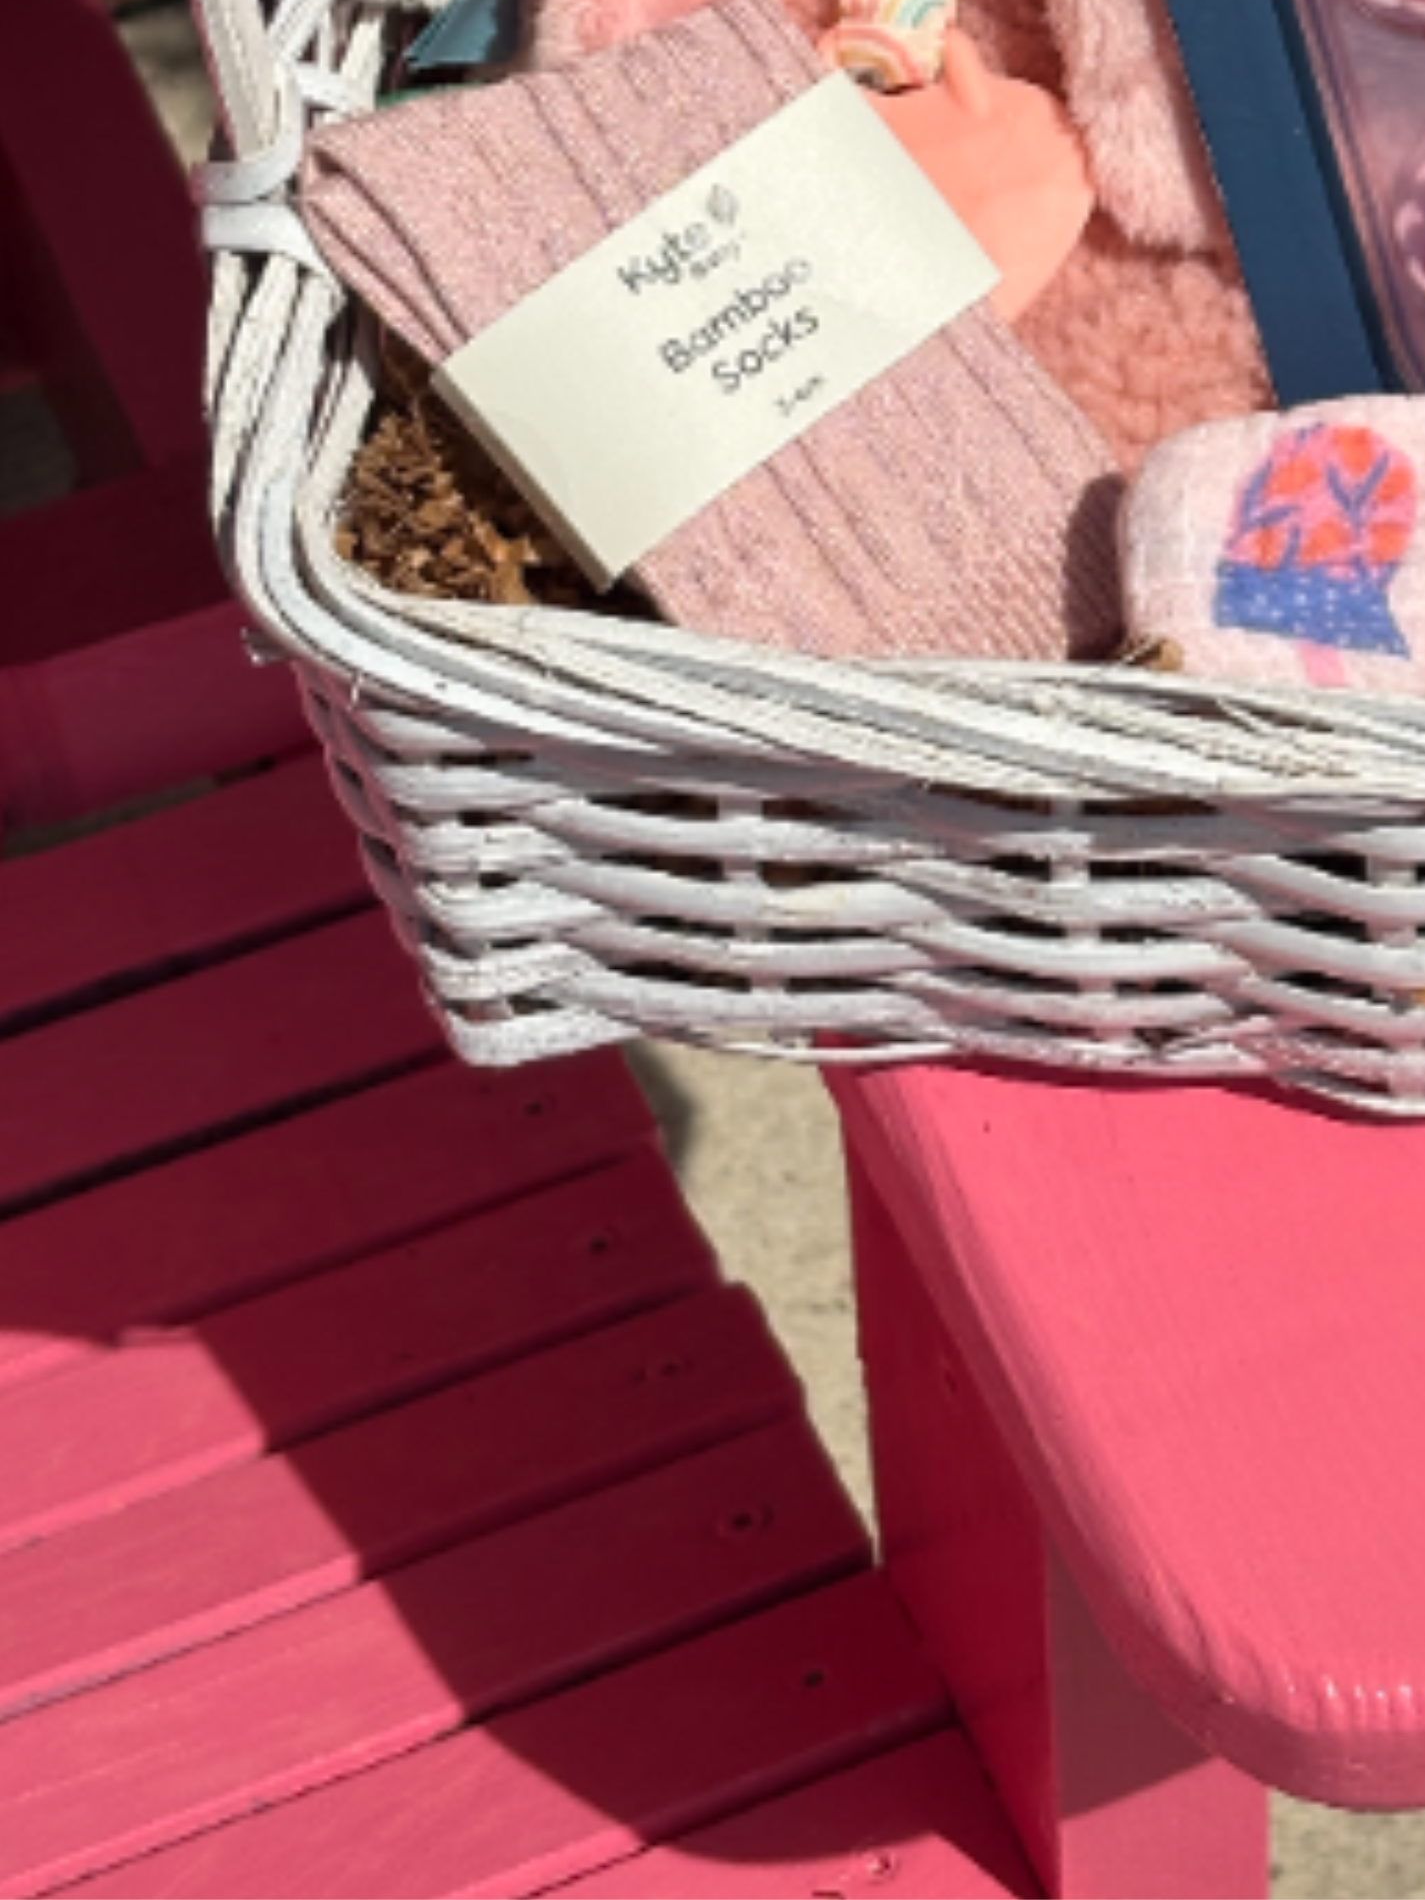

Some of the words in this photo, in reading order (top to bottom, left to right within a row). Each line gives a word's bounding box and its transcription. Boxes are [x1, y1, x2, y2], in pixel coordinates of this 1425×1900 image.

[617, 222, 713, 295] Kyte
[659, 258, 811, 374] Bamboo
[711, 306, 820, 394] Socks
